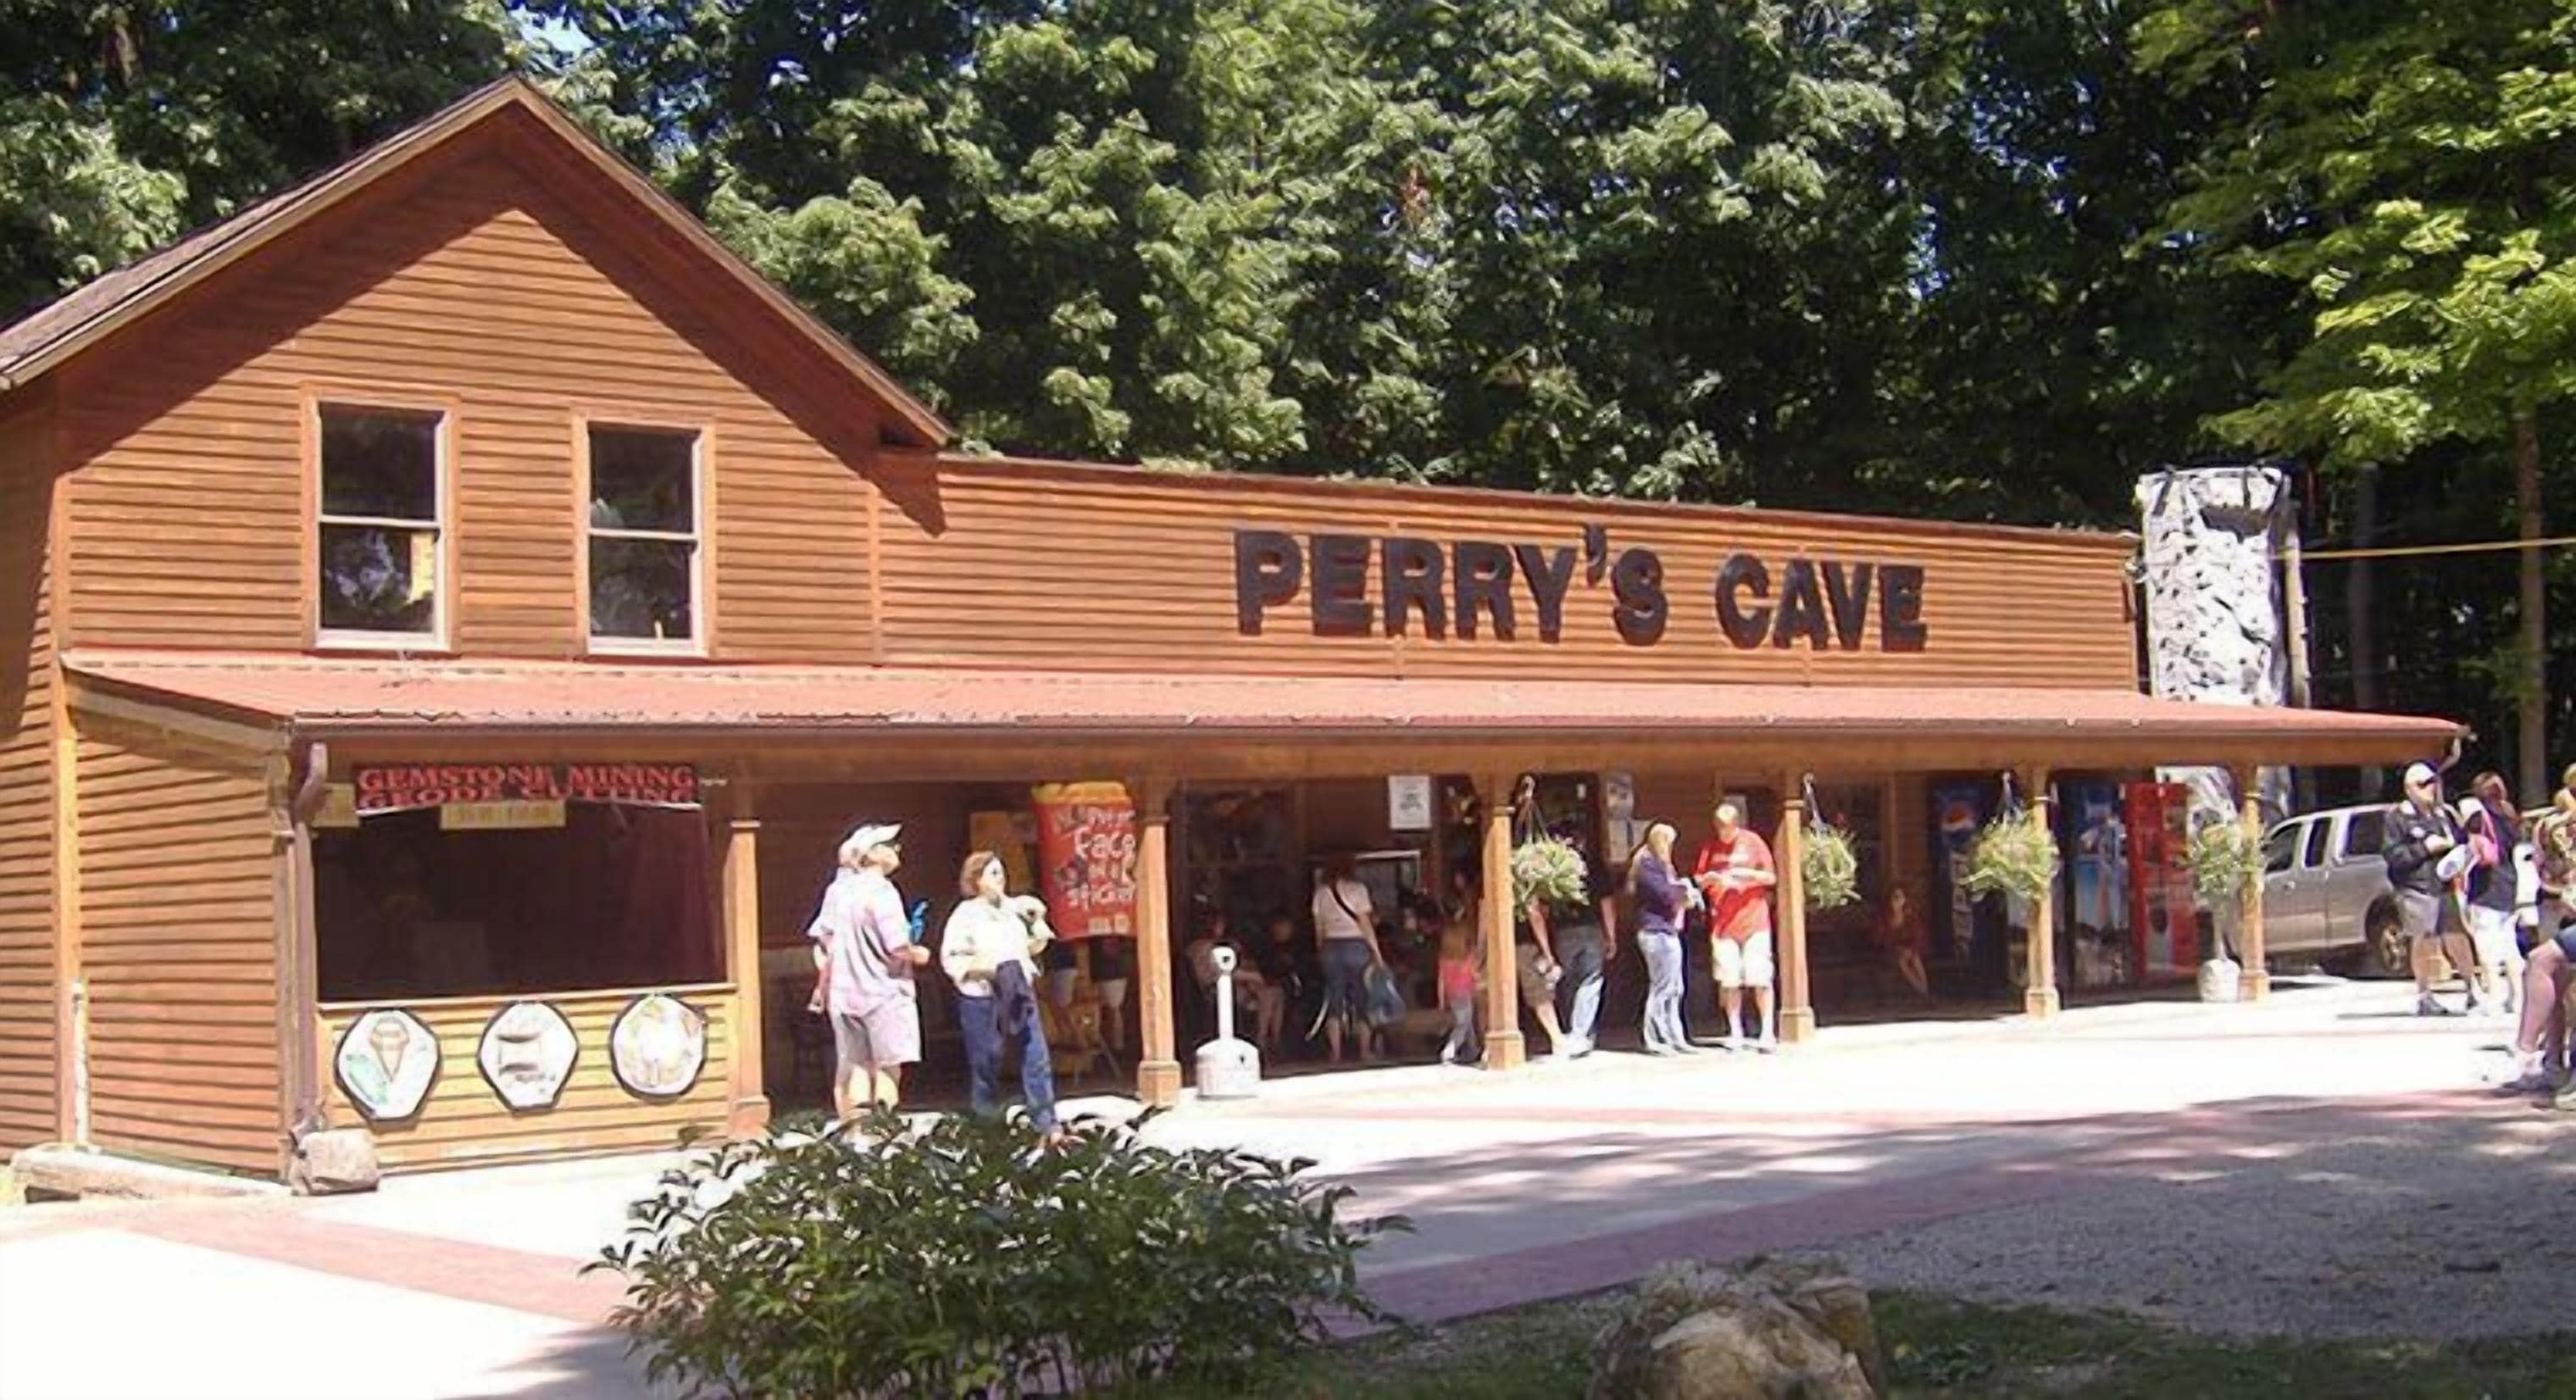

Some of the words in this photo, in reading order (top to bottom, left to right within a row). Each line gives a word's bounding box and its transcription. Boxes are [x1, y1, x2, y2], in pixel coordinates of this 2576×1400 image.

[1235, 523, 1668, 647] PERRY'S
[1716, 551, 1927, 652] CAVE
[358, 765, 552, 791] GEMSTONE
[569, 765, 693, 789] MINING
